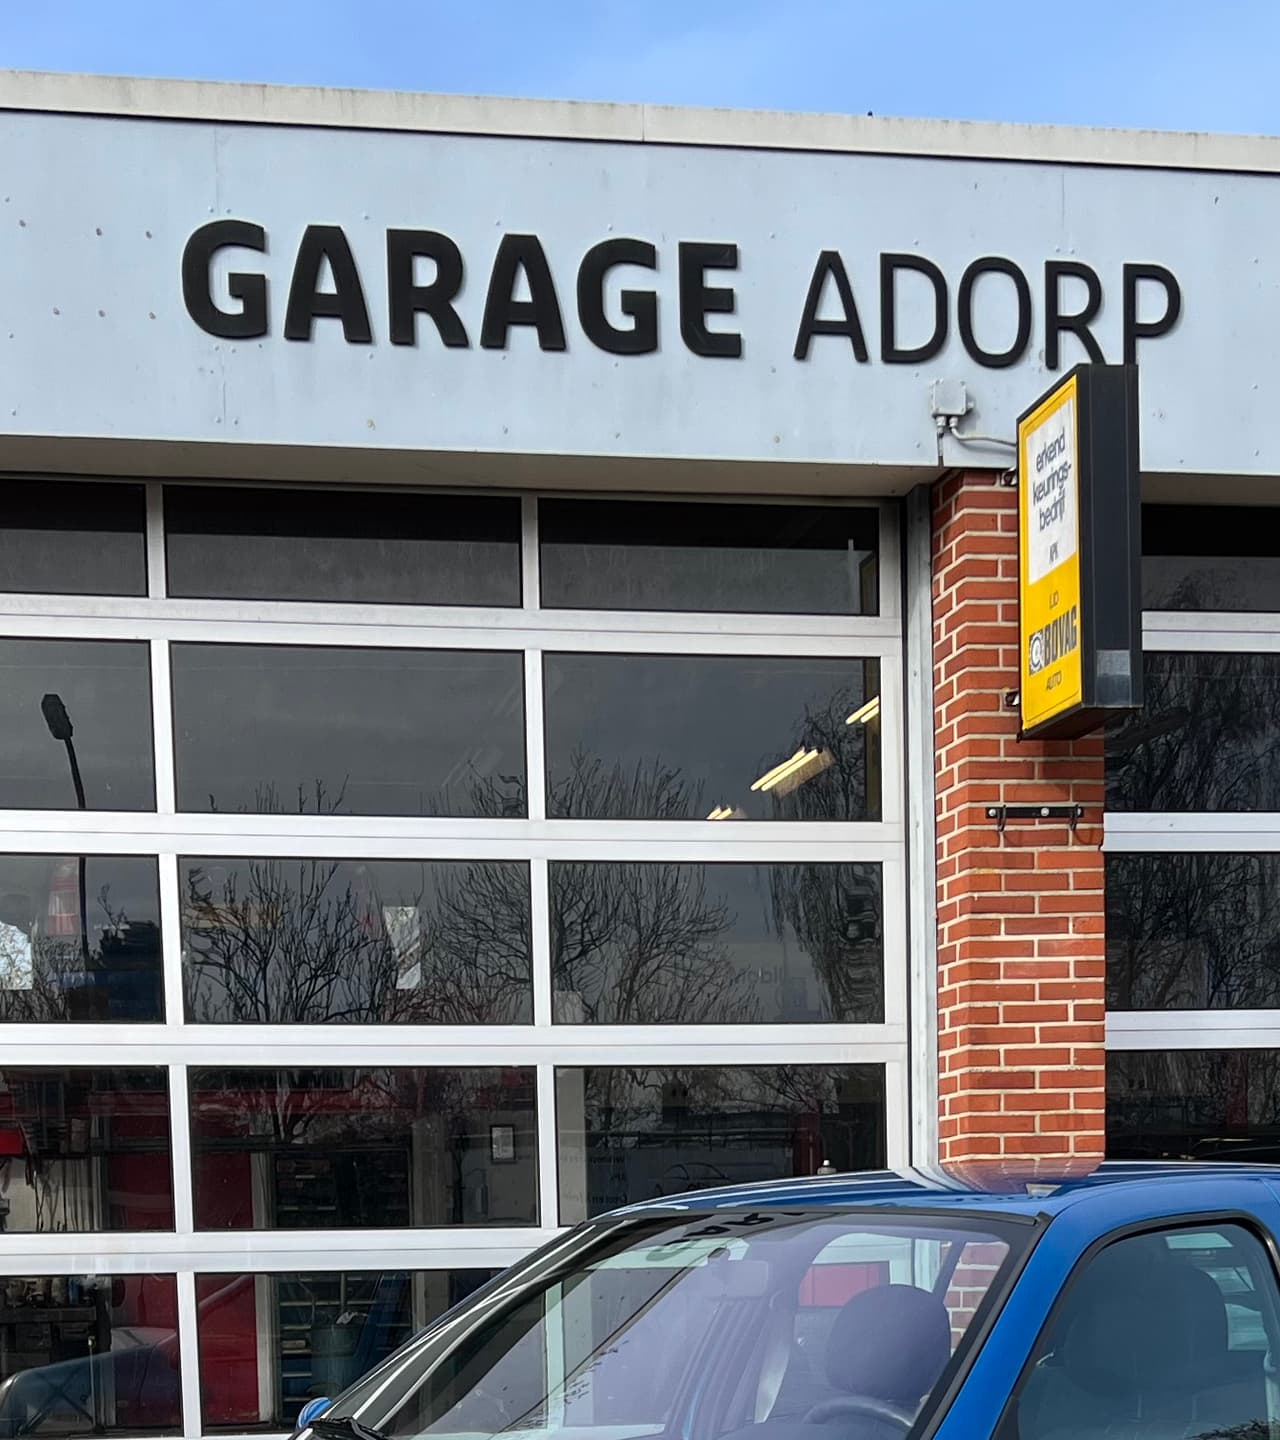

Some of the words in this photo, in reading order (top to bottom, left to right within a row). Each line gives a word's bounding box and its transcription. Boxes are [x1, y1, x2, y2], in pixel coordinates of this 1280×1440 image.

[181, 219, 743, 359] GARAGE
[792, 250, 1182, 371] ADORP
[1036, 427, 1066, 473] erkend
[1032, 460, 1072, 506] keurings-
[1038, 488, 1066, 532] bedrijf
[1043, 604, 1078, 668] BOVAG
[1046, 670, 1062, 691] AUTO
